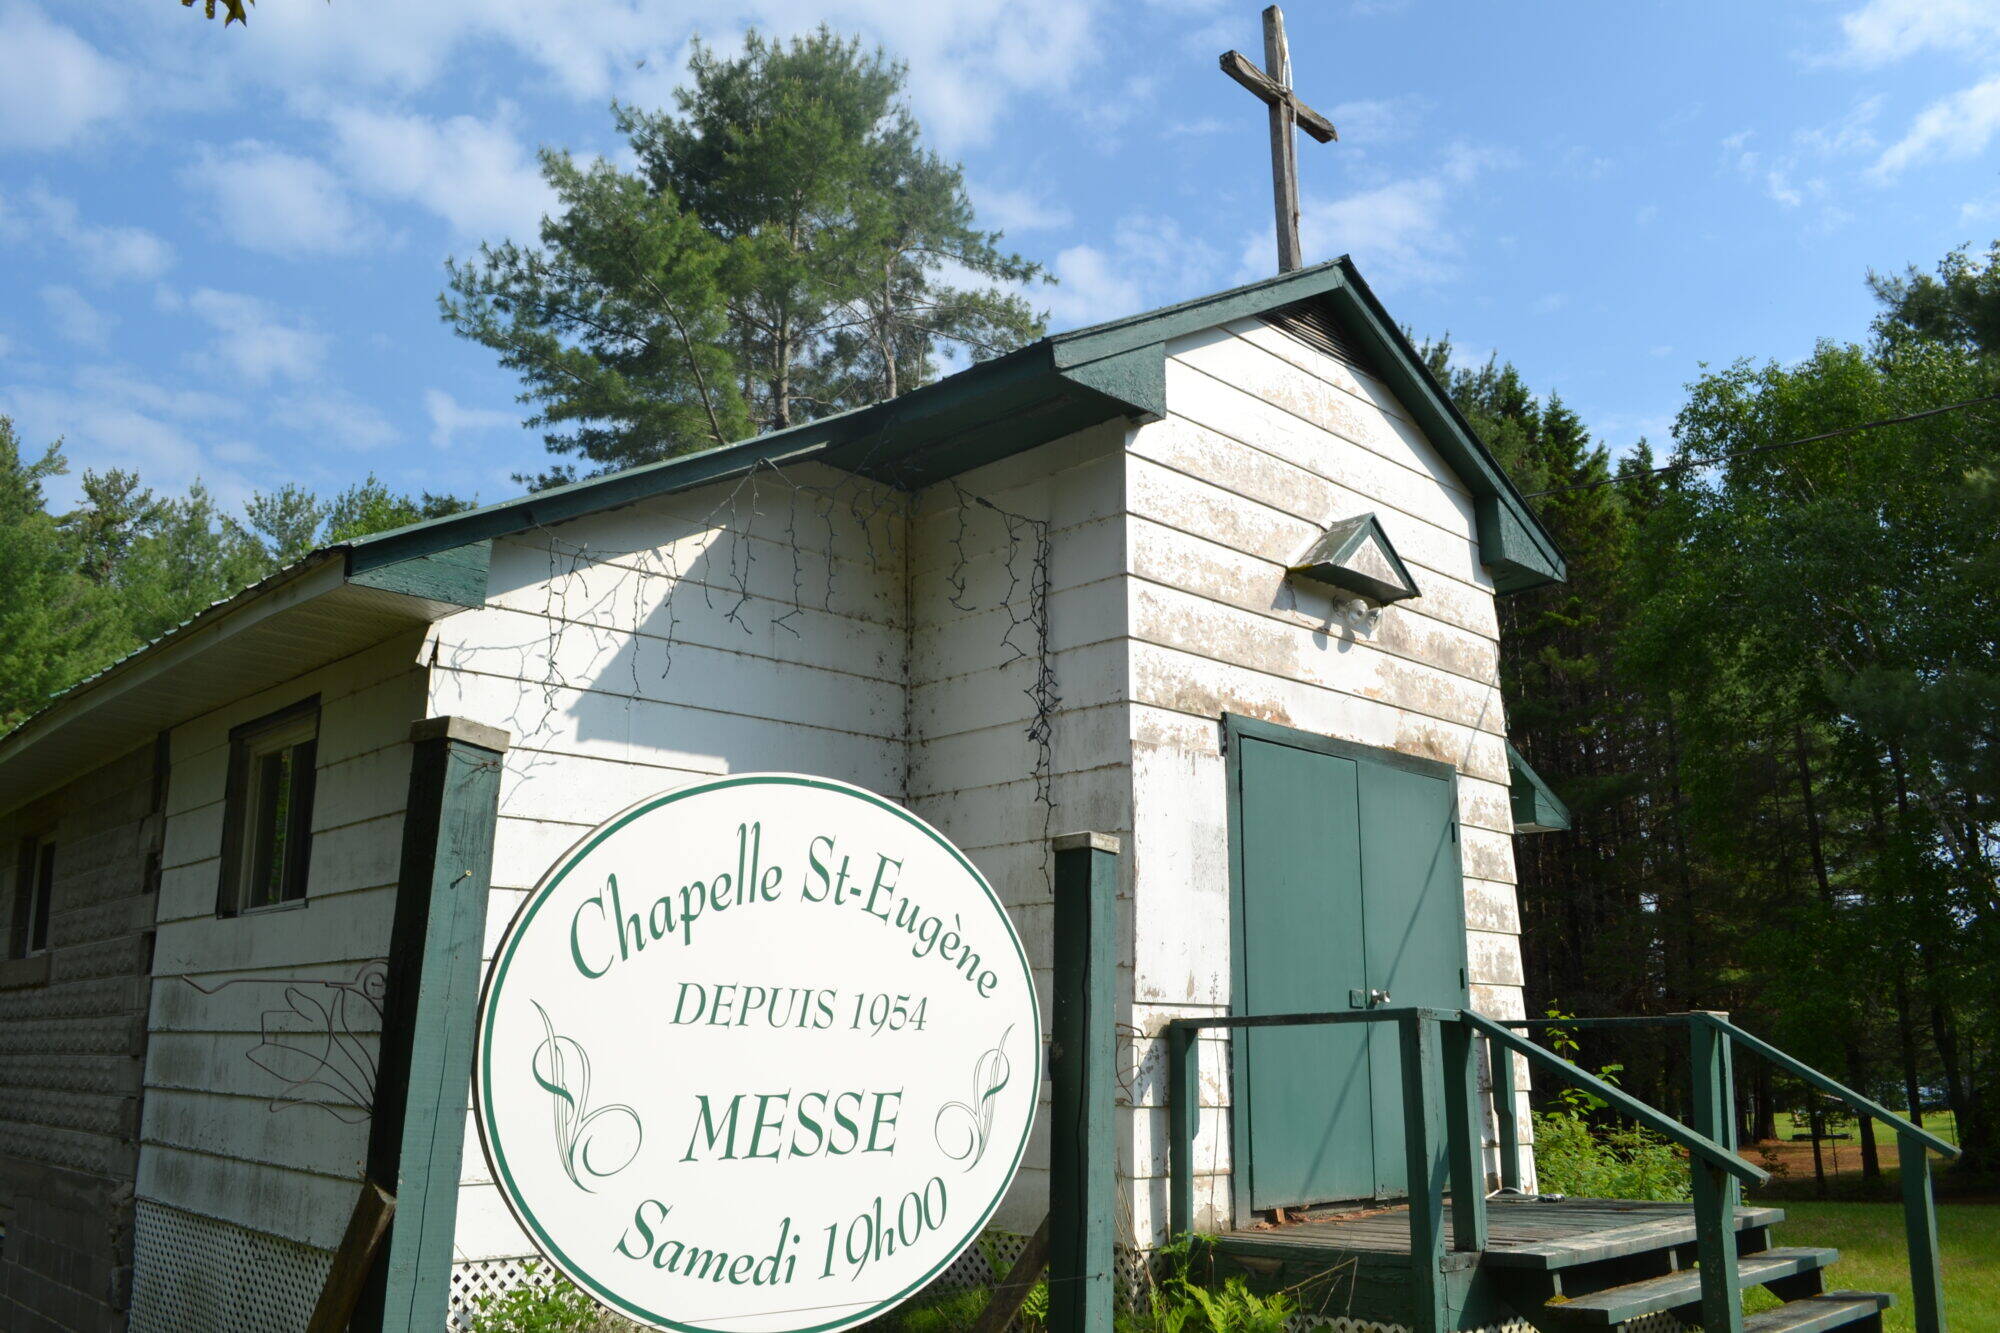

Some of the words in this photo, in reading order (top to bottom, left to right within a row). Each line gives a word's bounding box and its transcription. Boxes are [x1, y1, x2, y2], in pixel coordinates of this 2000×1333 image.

[570, 821, 782, 979] Chapelle
[801, 836, 997, 998] St-Eugène
[669, 983, 836, 1029] DEPUIS
[850, 994, 927, 1036] 1954
[679, 1086, 903, 1163] MESSE
[613, 1199, 800, 1286] Samedi
[818, 1177, 947, 1282] 19h00
